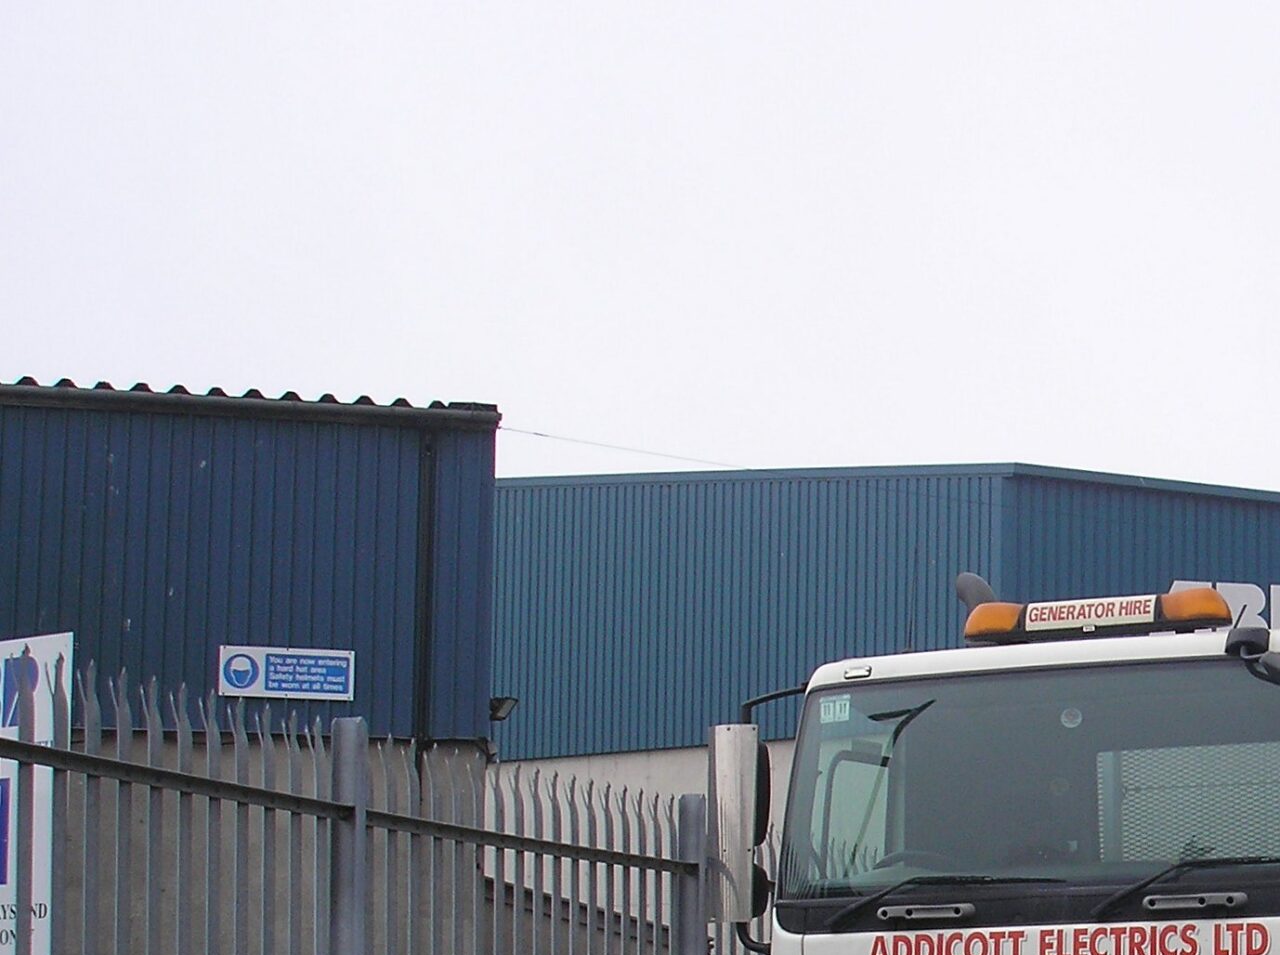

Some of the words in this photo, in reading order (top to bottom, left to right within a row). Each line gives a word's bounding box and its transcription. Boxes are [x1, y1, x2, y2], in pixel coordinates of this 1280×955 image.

[1028, 601, 1115, 623] GENERATOR
[1118, 599, 1152, 616] HIRE
[269, 656, 283, 664] You
[276, 664, 293, 672] hard
[296, 665, 308, 673] hat
[323, 683, 343, 691] times
